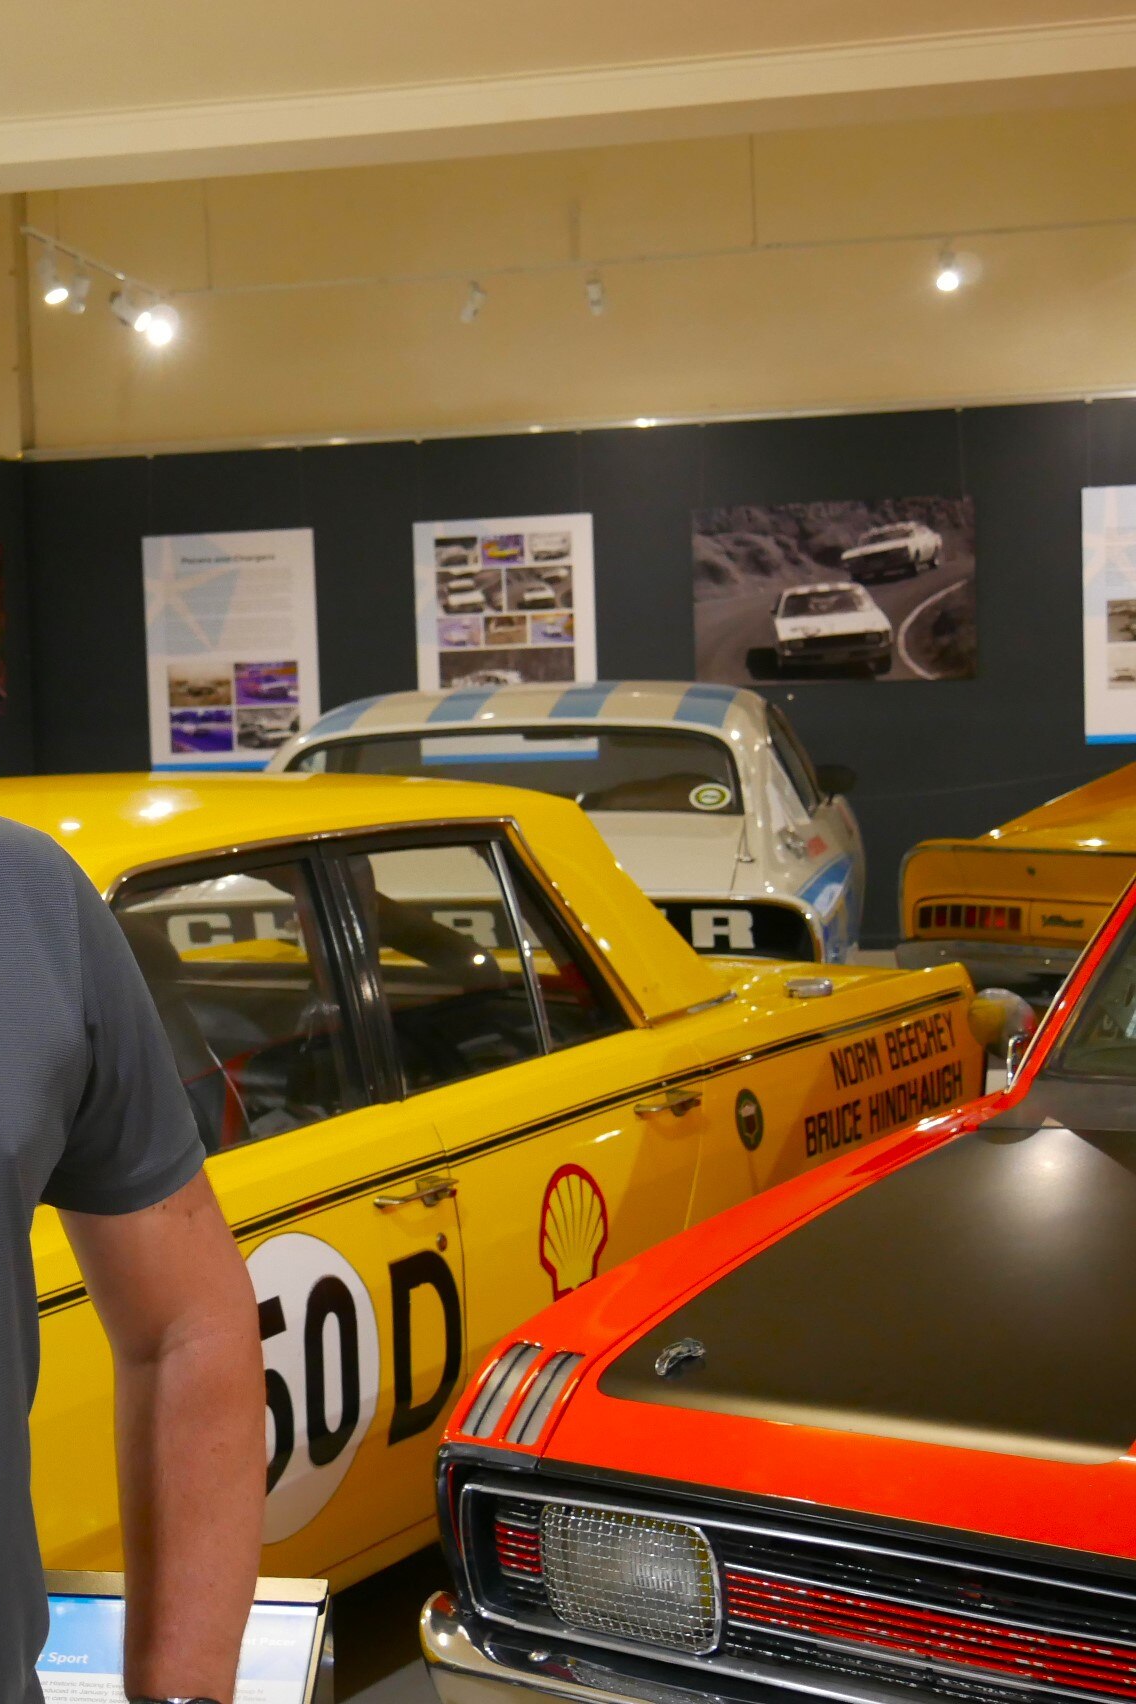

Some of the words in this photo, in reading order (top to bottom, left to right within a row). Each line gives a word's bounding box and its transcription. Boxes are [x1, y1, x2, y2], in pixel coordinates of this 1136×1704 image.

[830, 1037, 882, 1091] NORM
[884, 1010, 956, 1072] BEECHEY
[805, 1099, 862, 1158] BRUCE
[869, 1060, 964, 1134] HINDHAUGH
[388, 1249, 463, 1447] D
[48, 1651, 89, 1665] Sport
[259, 1636, 297, 1647] Pacer
[78, 1689, 108, 1697] January
